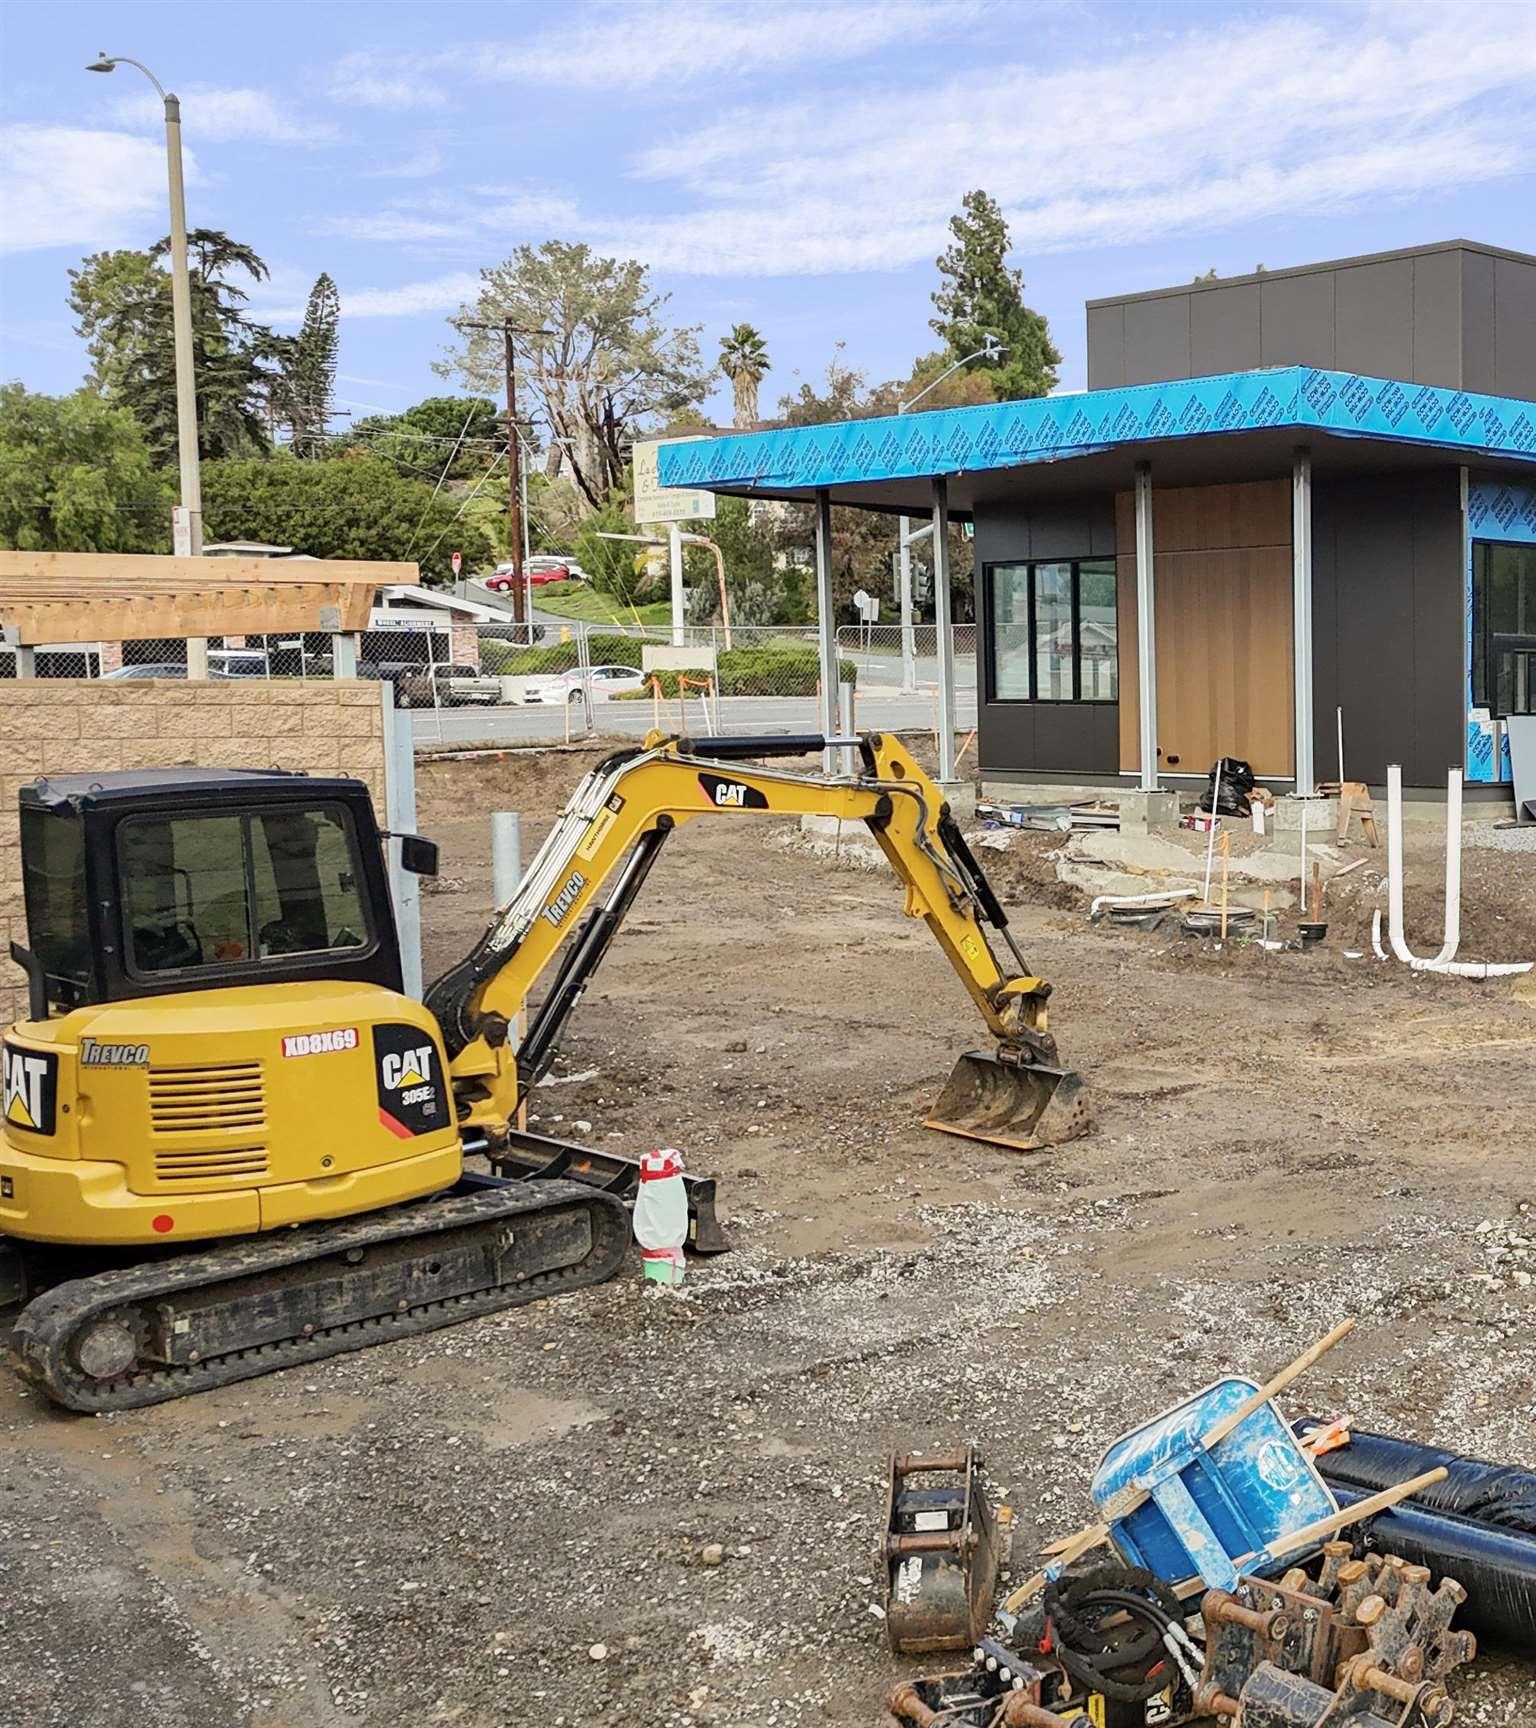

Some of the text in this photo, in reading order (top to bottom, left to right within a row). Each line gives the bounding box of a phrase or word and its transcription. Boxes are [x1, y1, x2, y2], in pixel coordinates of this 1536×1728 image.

[715, 783, 747, 806] CAT
[284, 1029, 357, 1057] XD8X69
[382, 1045, 433, 1091] CAT
[402, 1086, 436, 1107] 305E2
